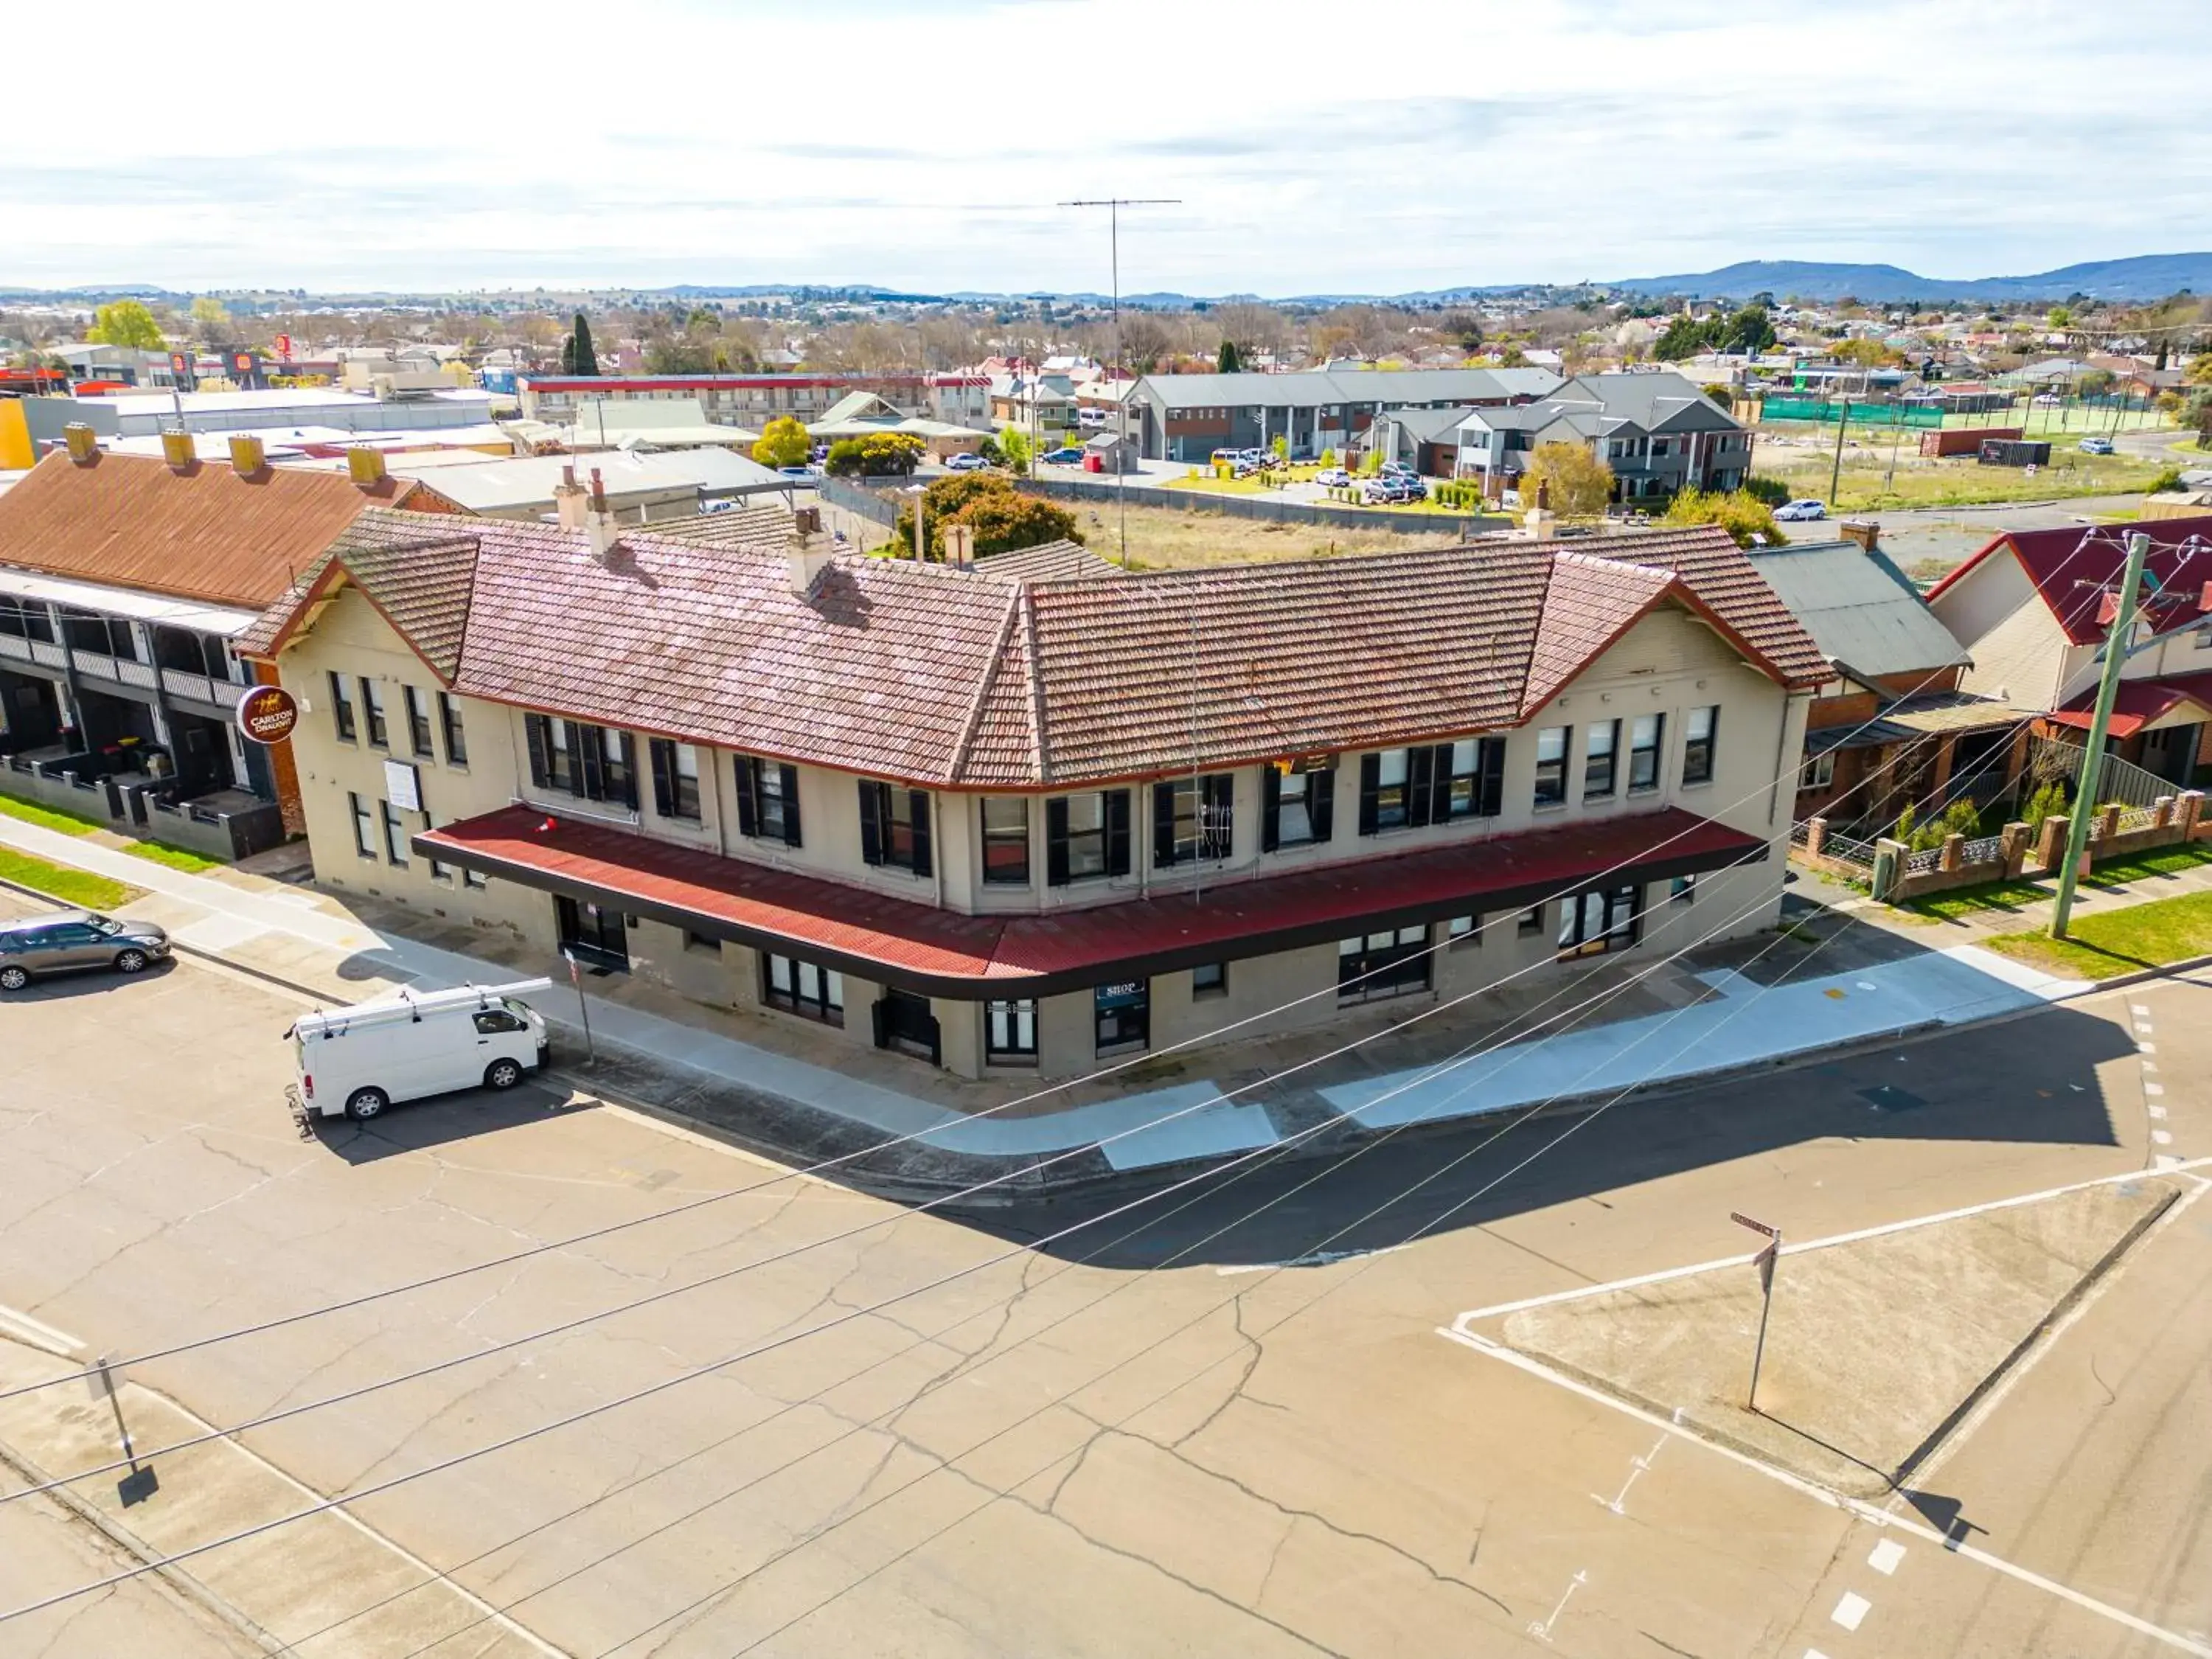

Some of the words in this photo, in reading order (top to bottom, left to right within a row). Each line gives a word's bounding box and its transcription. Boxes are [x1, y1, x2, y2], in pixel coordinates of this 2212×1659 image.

[251, 709, 293, 726] CARLTON
[255, 718, 291, 733] DRAUGHT
[1107, 983, 1135, 997] SHOP
